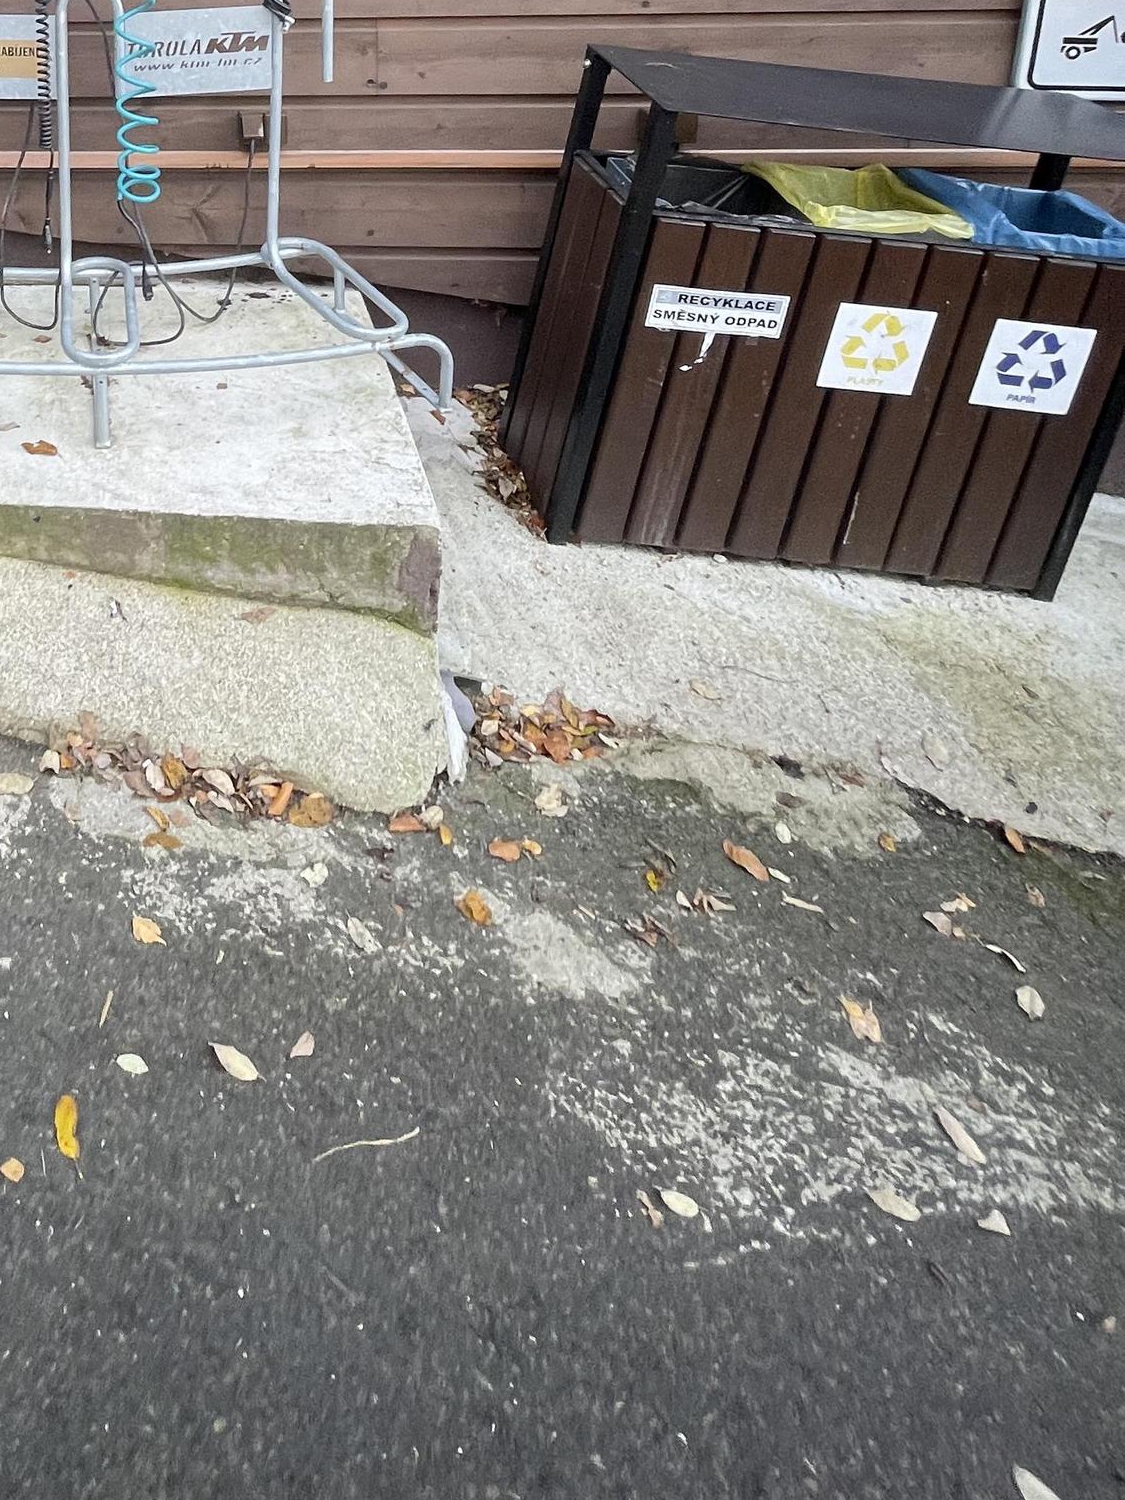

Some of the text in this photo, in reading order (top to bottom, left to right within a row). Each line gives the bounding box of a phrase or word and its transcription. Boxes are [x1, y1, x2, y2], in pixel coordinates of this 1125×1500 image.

[204, 31, 270, 54] KTM
[678, 293, 777, 312] RECYKLACE
[652, 308, 778, 330] SMĚSNÝ ODPAD
